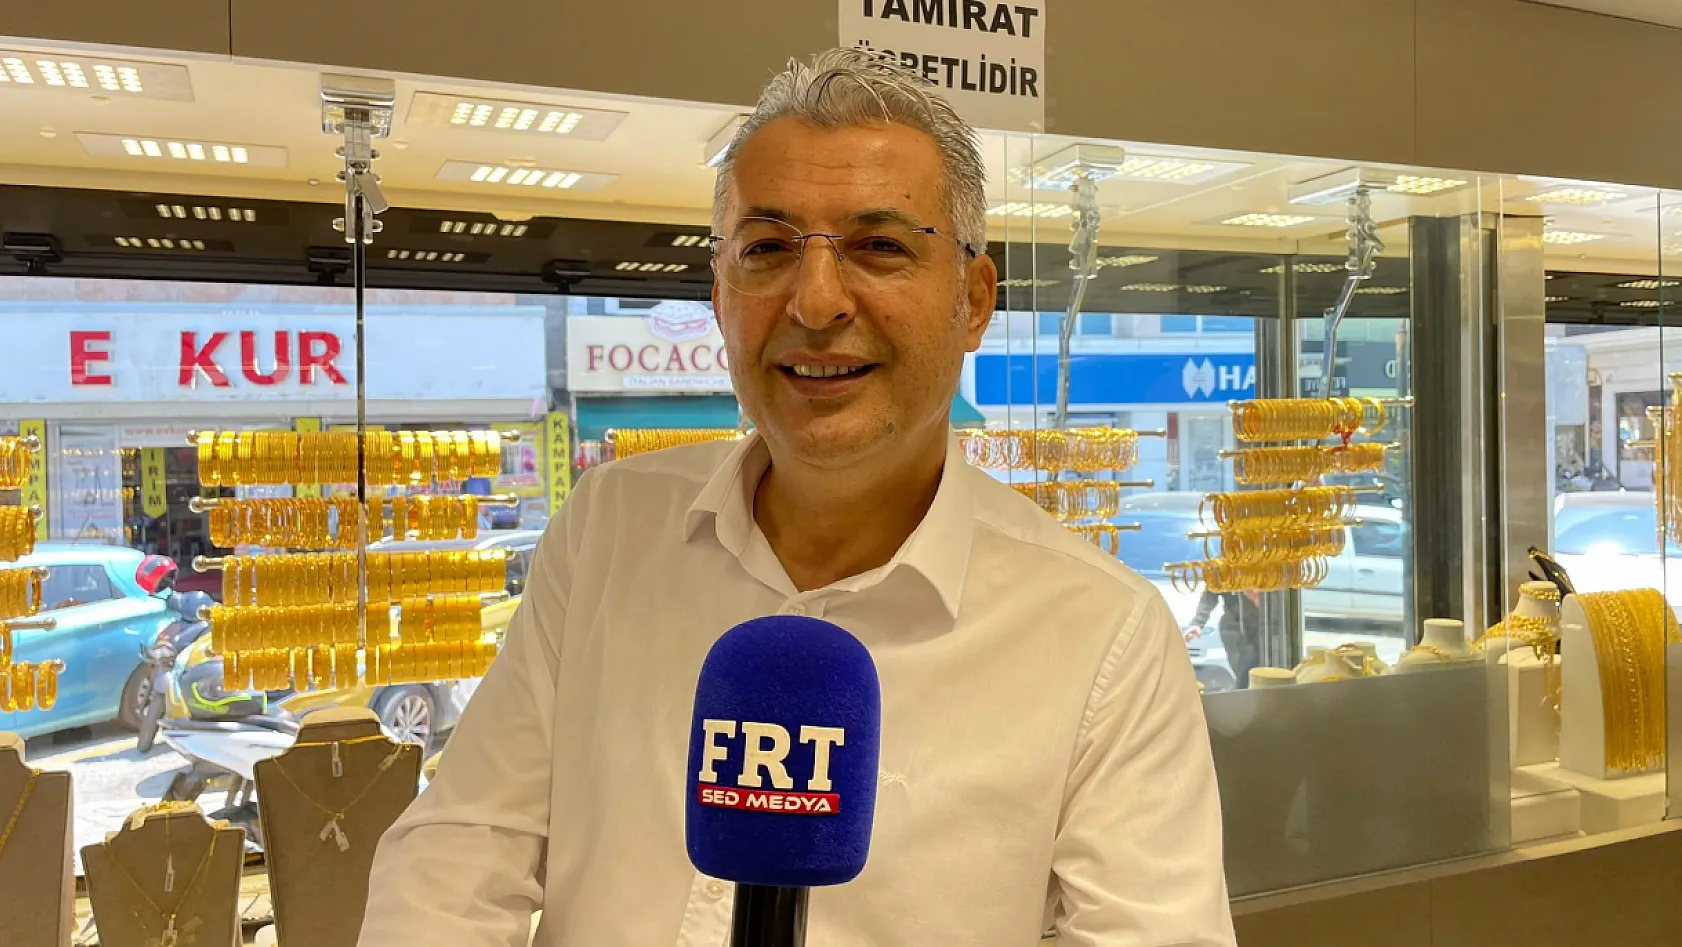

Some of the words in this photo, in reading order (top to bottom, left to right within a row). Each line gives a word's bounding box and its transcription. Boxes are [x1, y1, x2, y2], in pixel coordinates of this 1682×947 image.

[179, 331, 349, 387] KUR
[699, 719, 844, 791] FRT
[702, 789, 739, 806] SED
[746, 793, 832, 812] MEDYA
